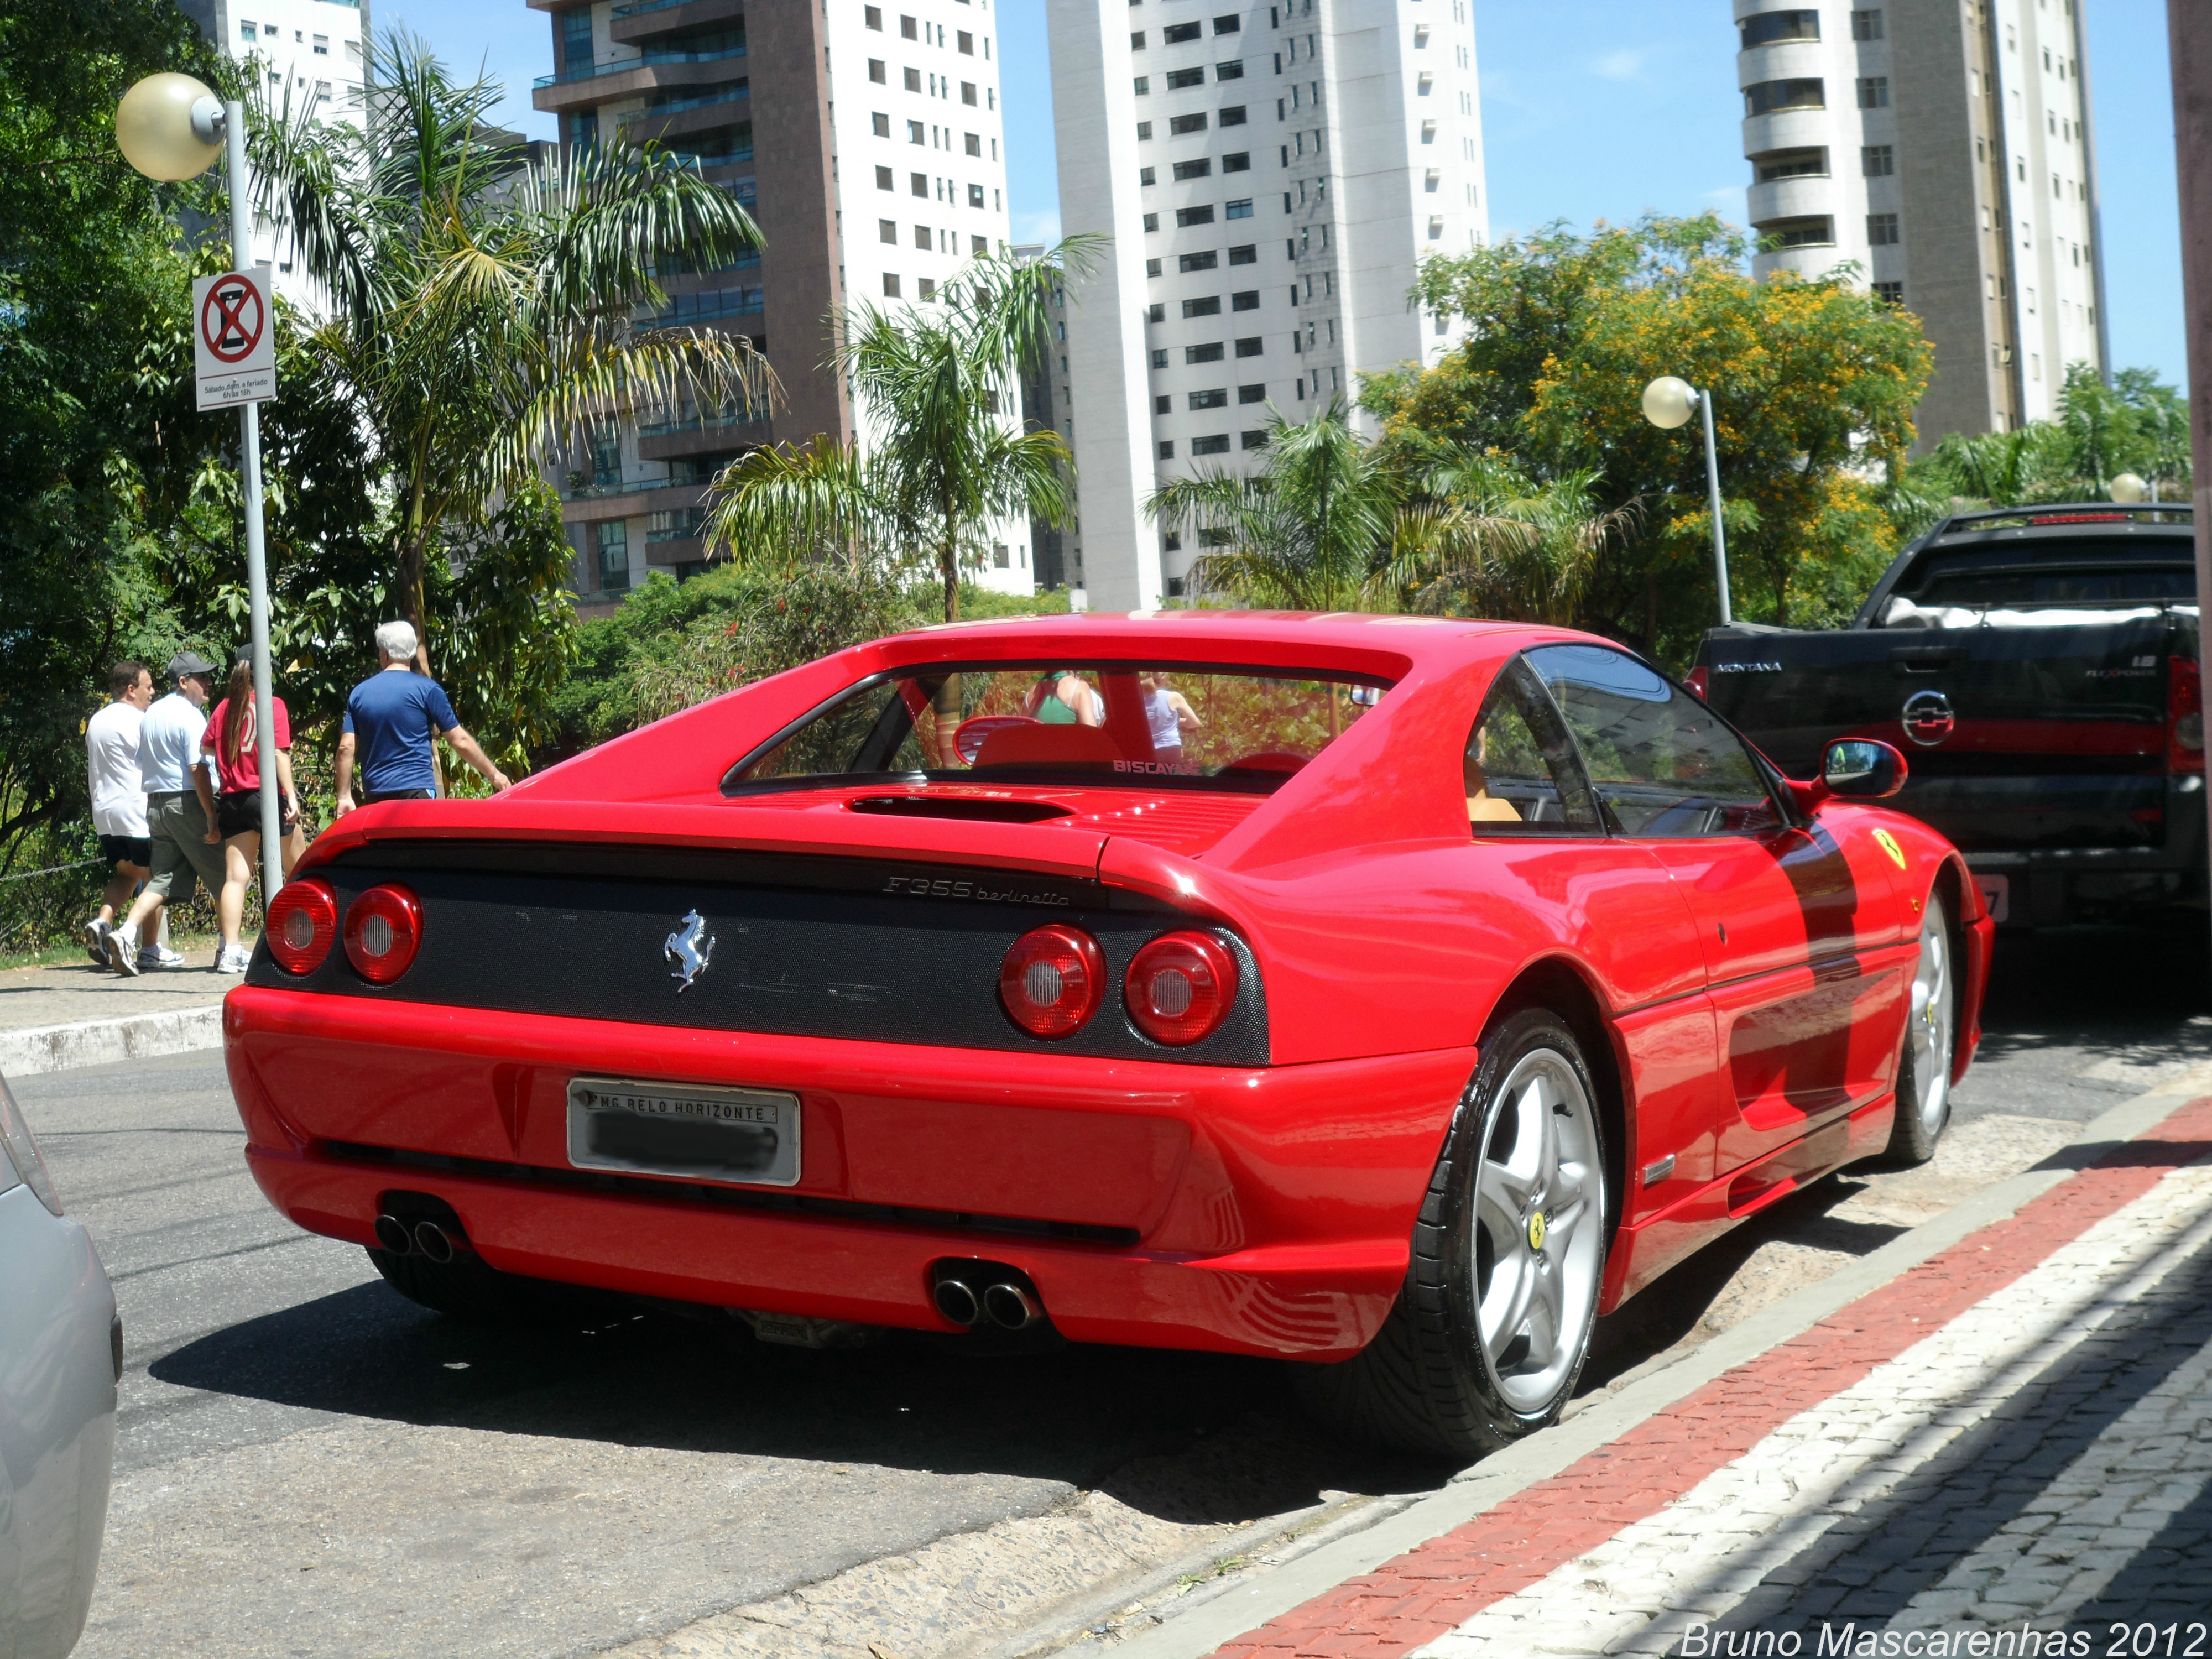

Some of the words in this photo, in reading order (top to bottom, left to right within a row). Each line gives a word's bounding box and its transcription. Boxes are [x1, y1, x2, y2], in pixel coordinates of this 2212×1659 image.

[247, 379, 268, 388] feriado
[1718, 662, 1782, 672] MONTANA
[1113, 759, 1202, 775] BISCAYNE
[883, 877, 973, 898] F355
[977, 887, 1069, 906] berlinetta
[675, 1102, 764, 1120] HORIZONTE
